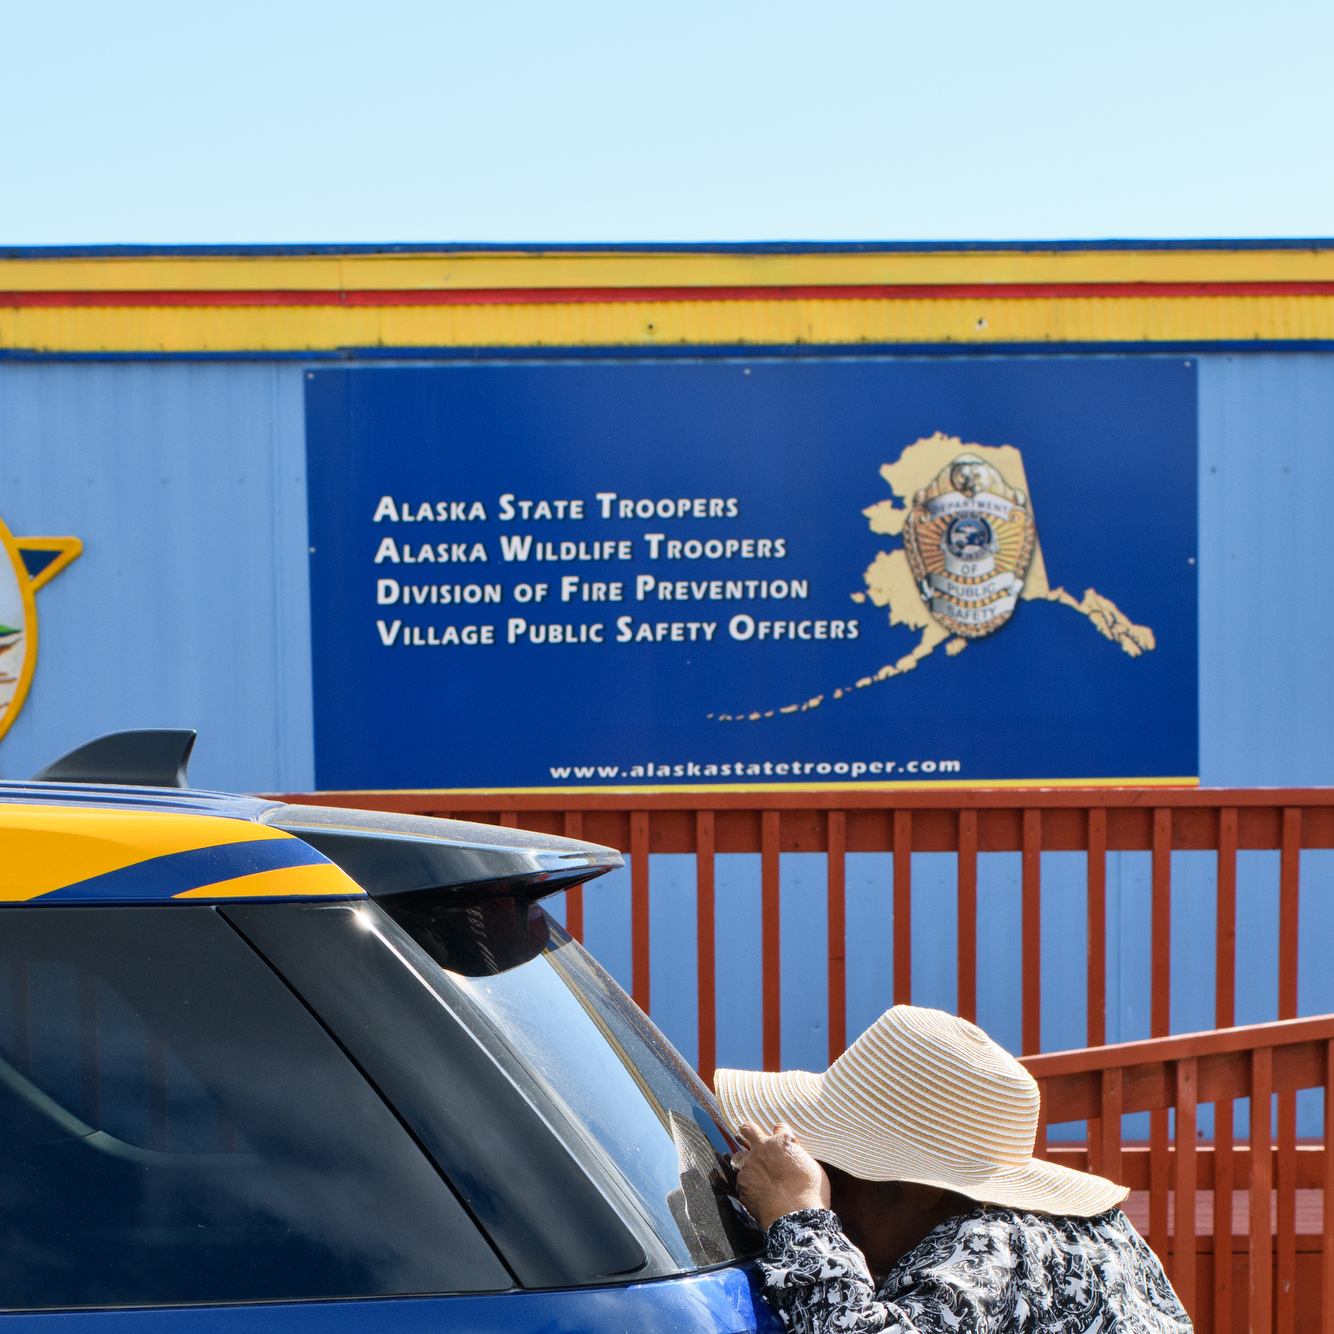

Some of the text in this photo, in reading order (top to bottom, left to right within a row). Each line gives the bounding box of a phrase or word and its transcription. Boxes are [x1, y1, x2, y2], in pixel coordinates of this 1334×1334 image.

[932, 499, 1008, 515] DEPARTMENT
[960, 564, 978, 575] OF
[947, 581, 996, 597] PUBLIC
[947, 604, 998, 620] SAFETY
[549, 760, 961, 779] www.alaskastatetrooper.com
